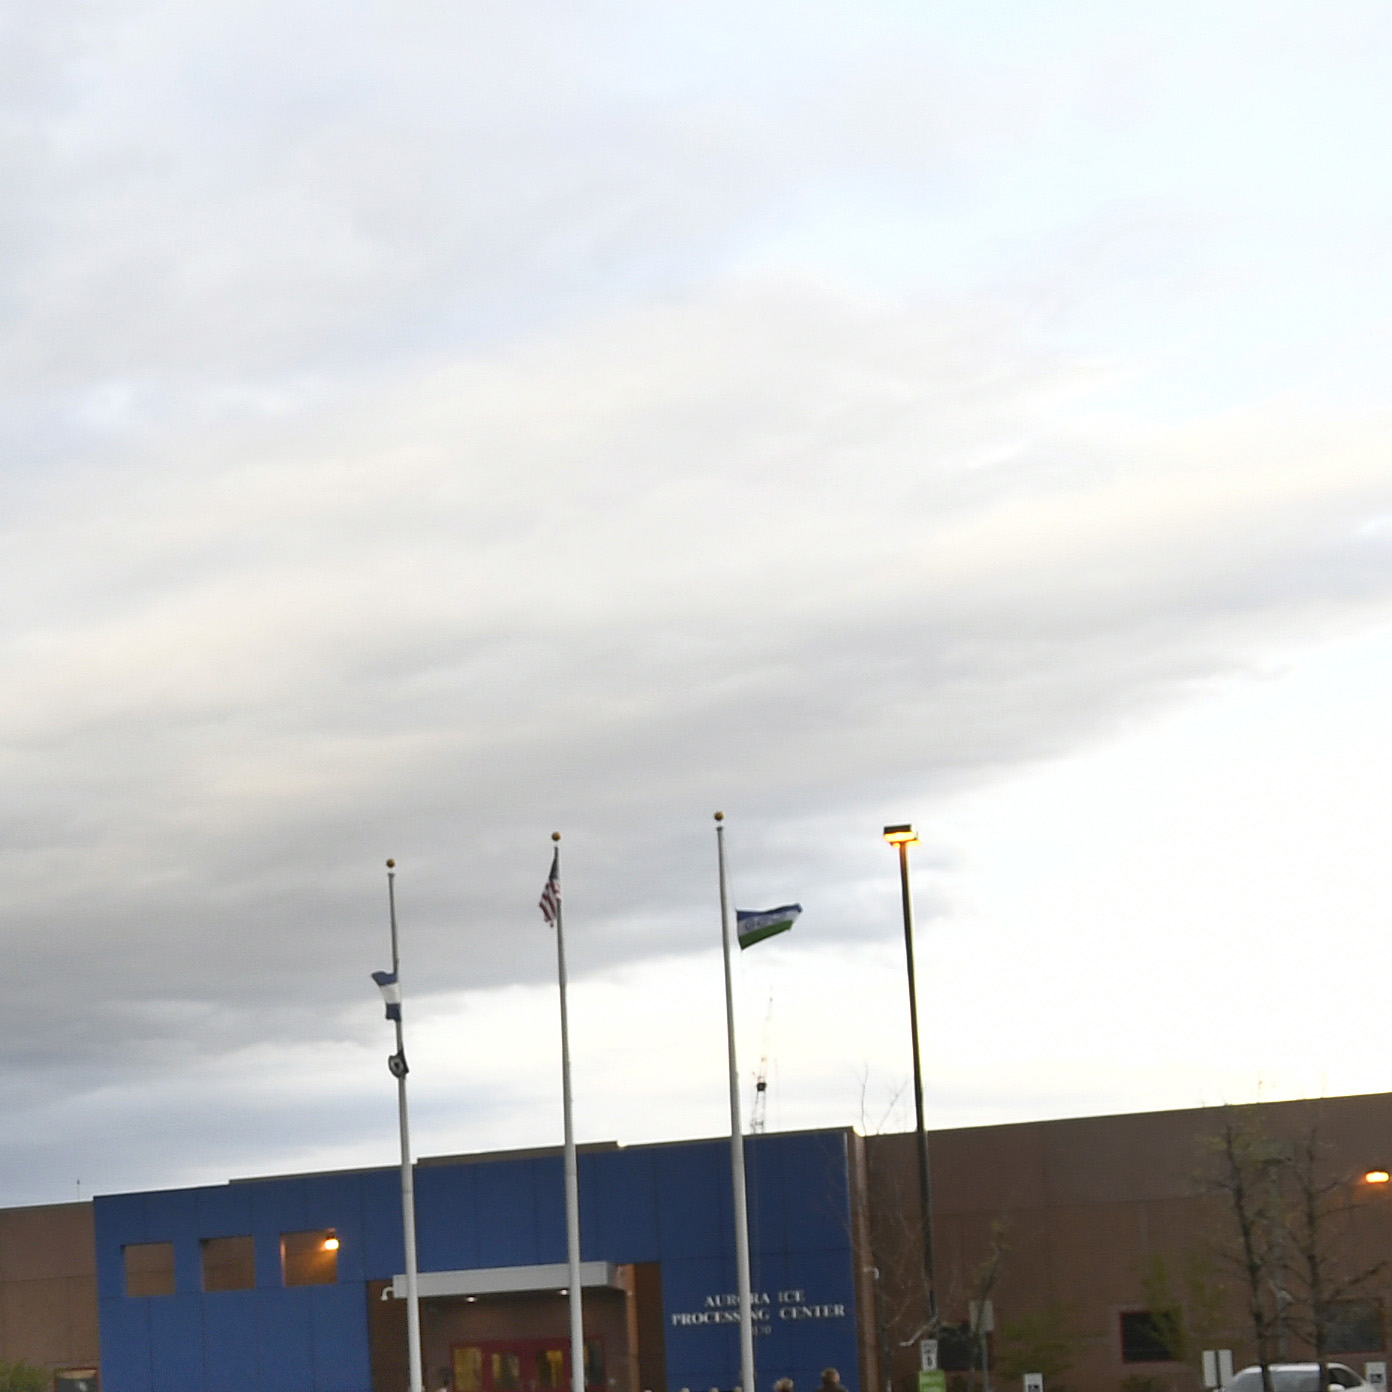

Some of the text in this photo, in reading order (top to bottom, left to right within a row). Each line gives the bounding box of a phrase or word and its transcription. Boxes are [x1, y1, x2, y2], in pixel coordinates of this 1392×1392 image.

[705, 1290, 805, 1308] AURRA ICE
[671, 1304, 846, 1326] PROCESSNG CENTER
